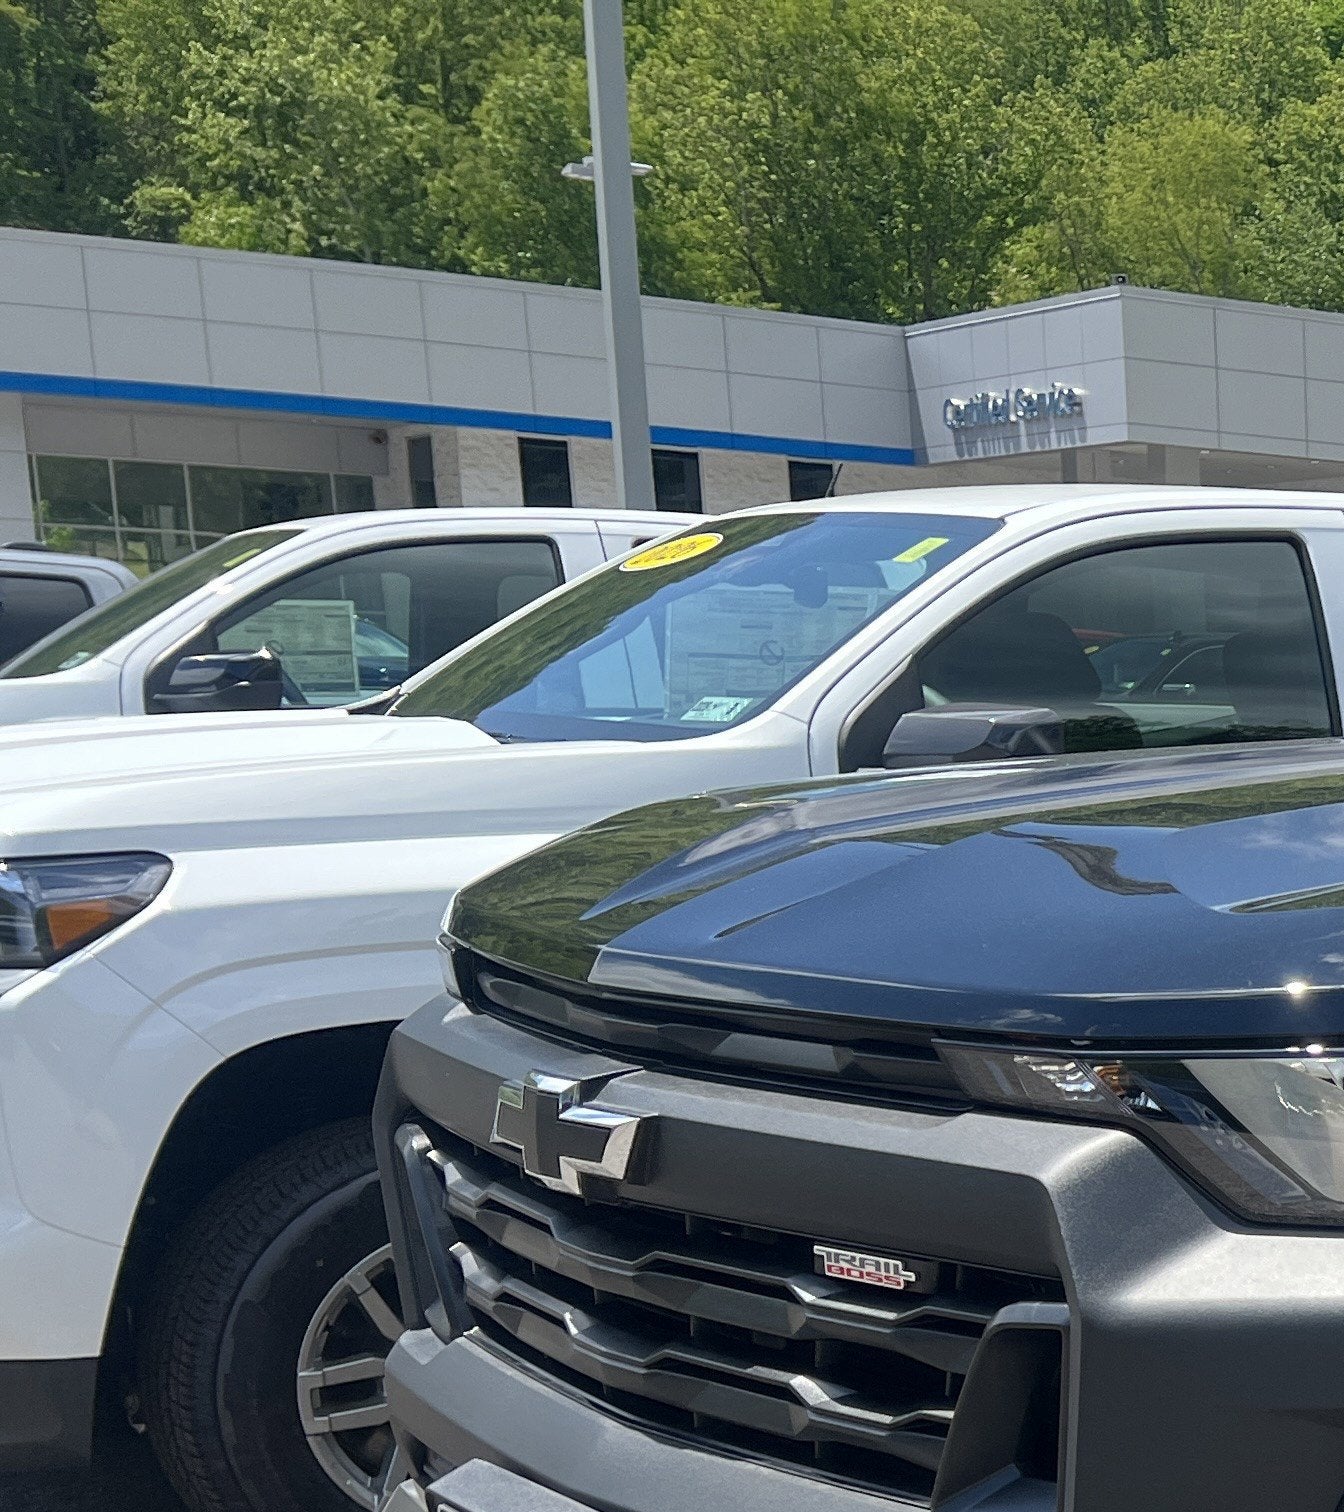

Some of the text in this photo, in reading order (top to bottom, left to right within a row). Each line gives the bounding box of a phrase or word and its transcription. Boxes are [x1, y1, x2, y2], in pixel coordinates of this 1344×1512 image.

[943, 382, 1083, 429] Certified Service
[814, 1246, 915, 1281] TRAIL
[826, 1264, 902, 1287] BOSS
